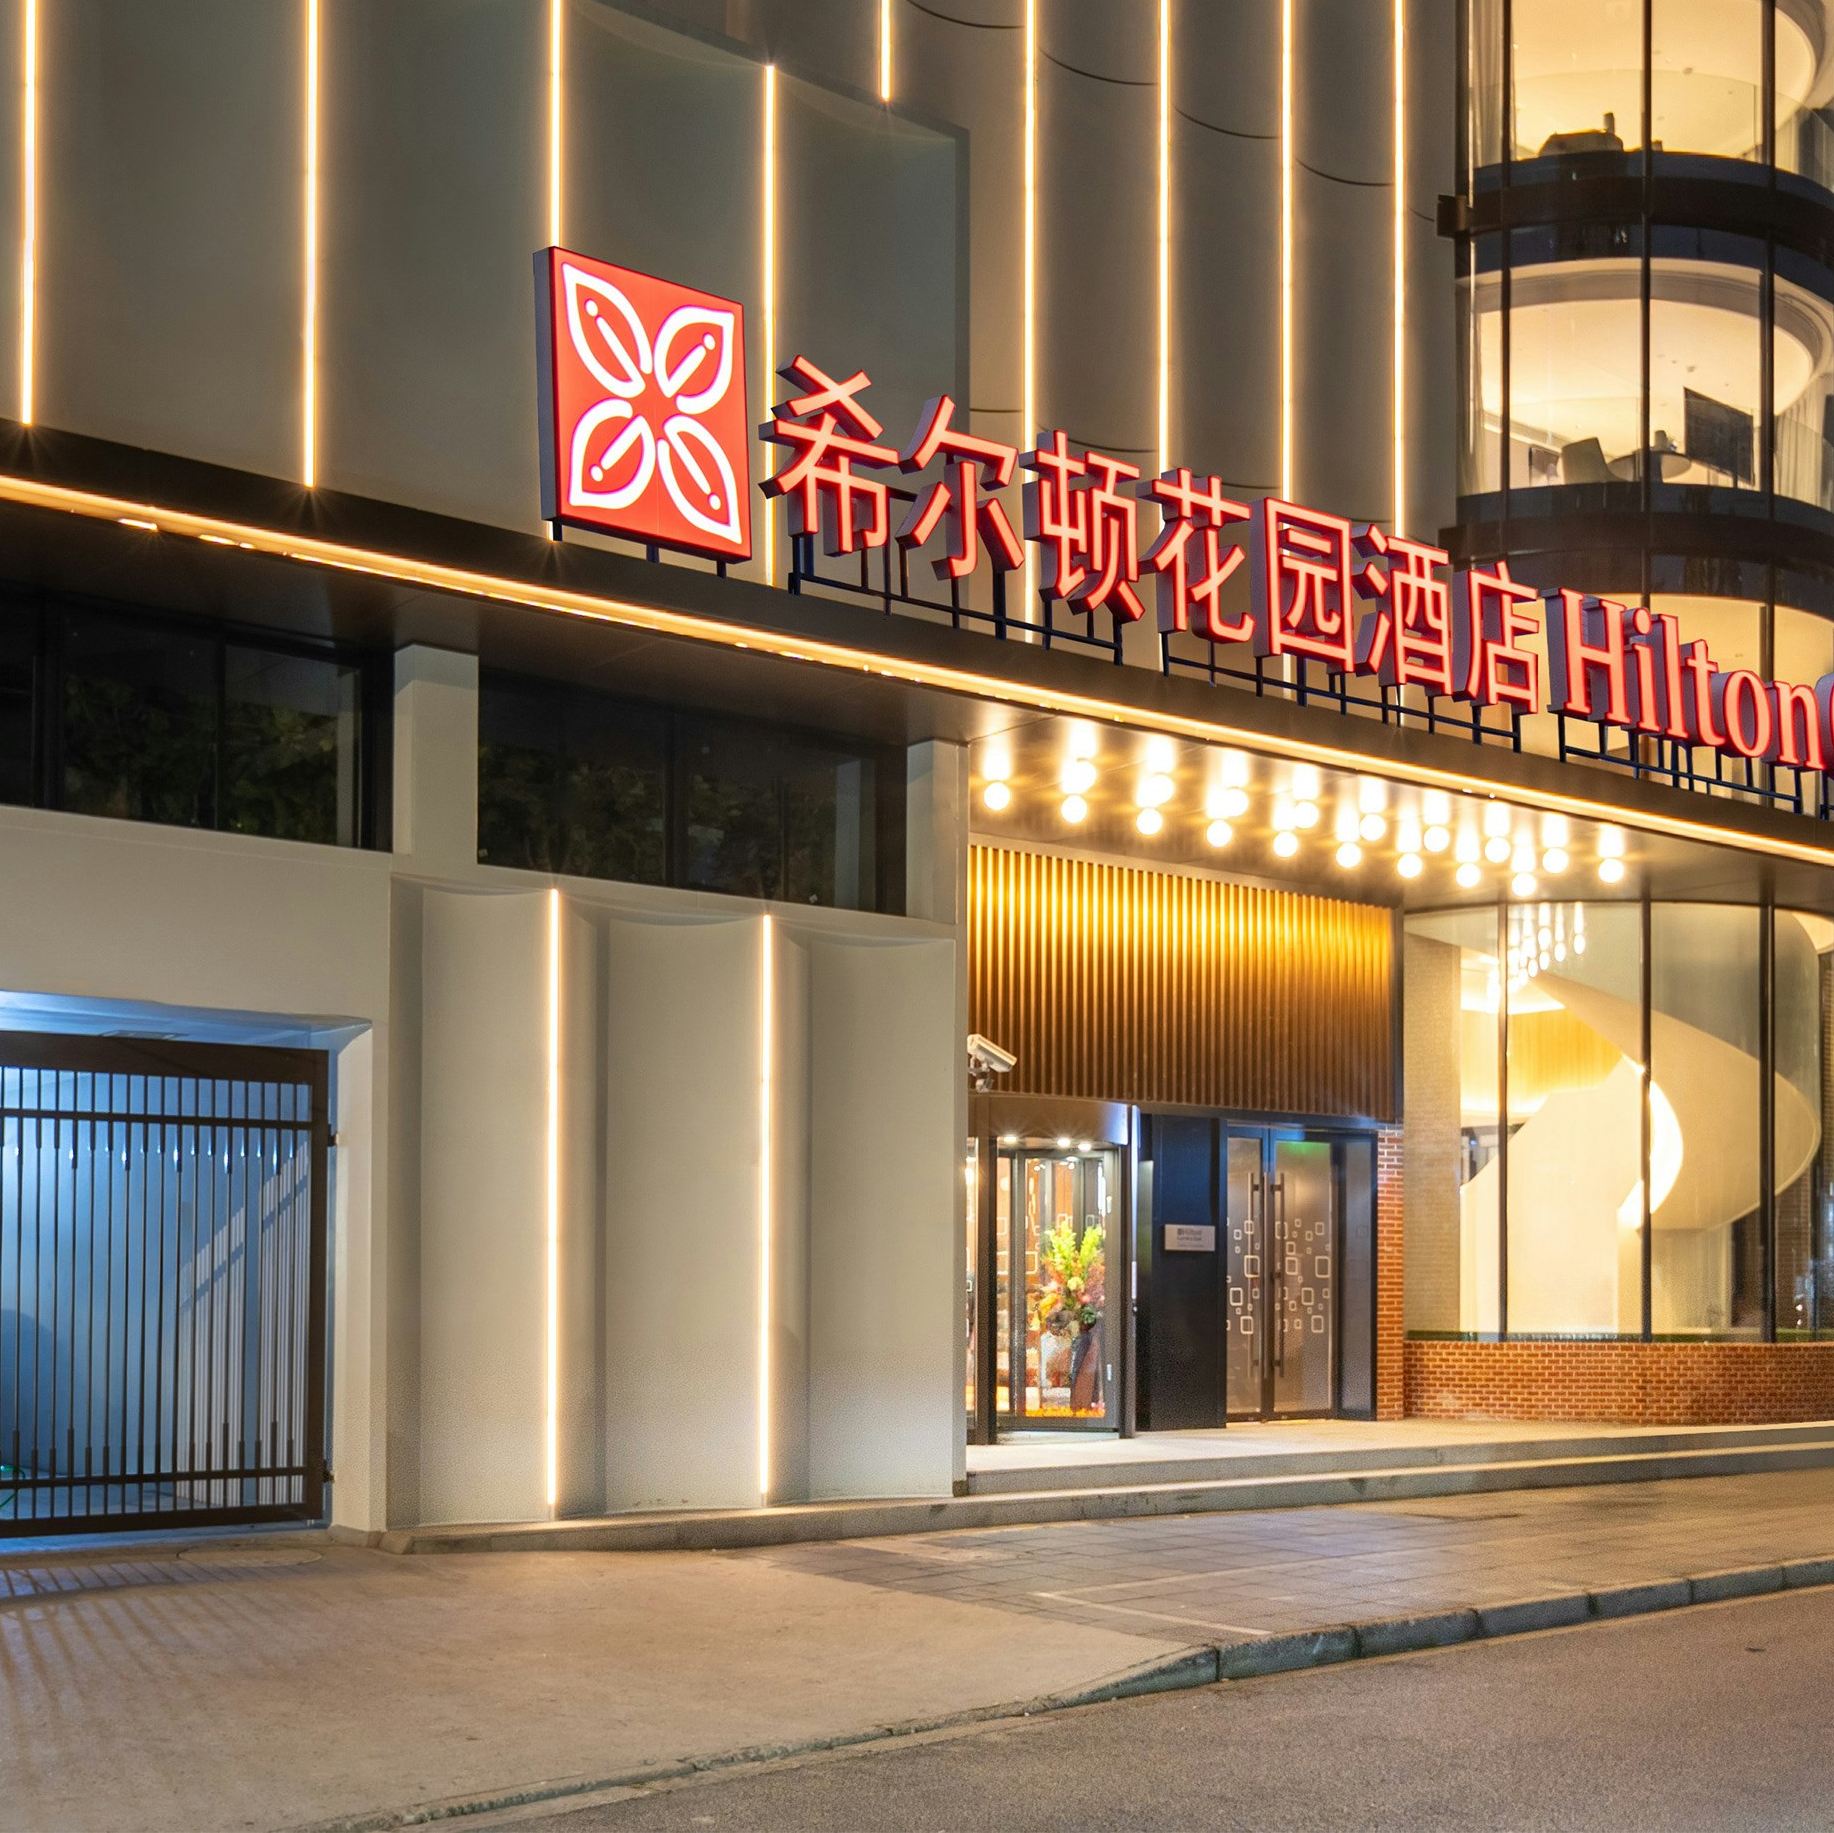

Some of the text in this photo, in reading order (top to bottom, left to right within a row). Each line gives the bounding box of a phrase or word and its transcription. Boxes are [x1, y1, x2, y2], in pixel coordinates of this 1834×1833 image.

[770, 354, 1540, 715] 希尔顿花园酒店
[1554, 587, 1826, 771] Hilton
